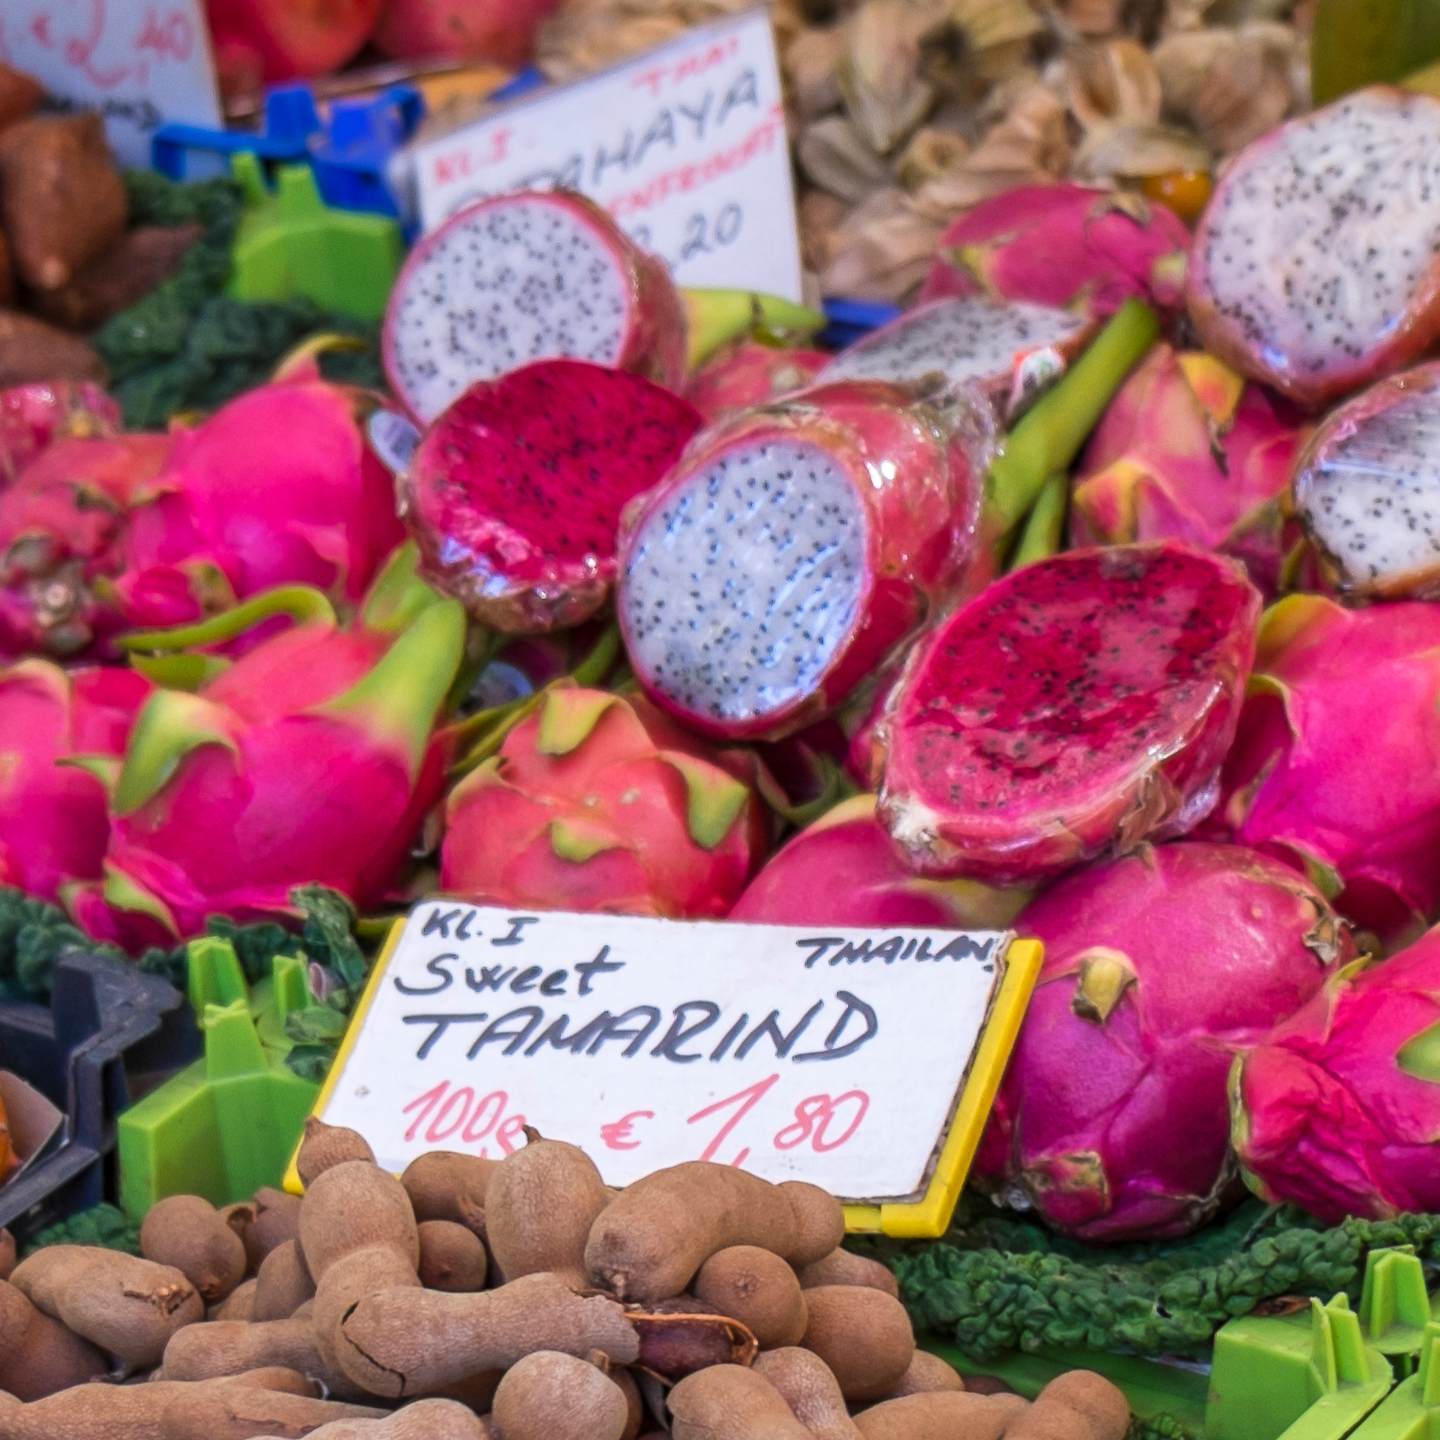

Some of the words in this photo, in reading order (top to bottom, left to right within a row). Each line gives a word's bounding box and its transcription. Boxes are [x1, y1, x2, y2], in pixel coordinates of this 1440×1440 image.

[393, 944, 626, 996] Sweet
[401, 991, 879, 1063] TAMARIND
[600, 1110, 655, 1151] €
[685, 1072, 871, 1168] 1,80
